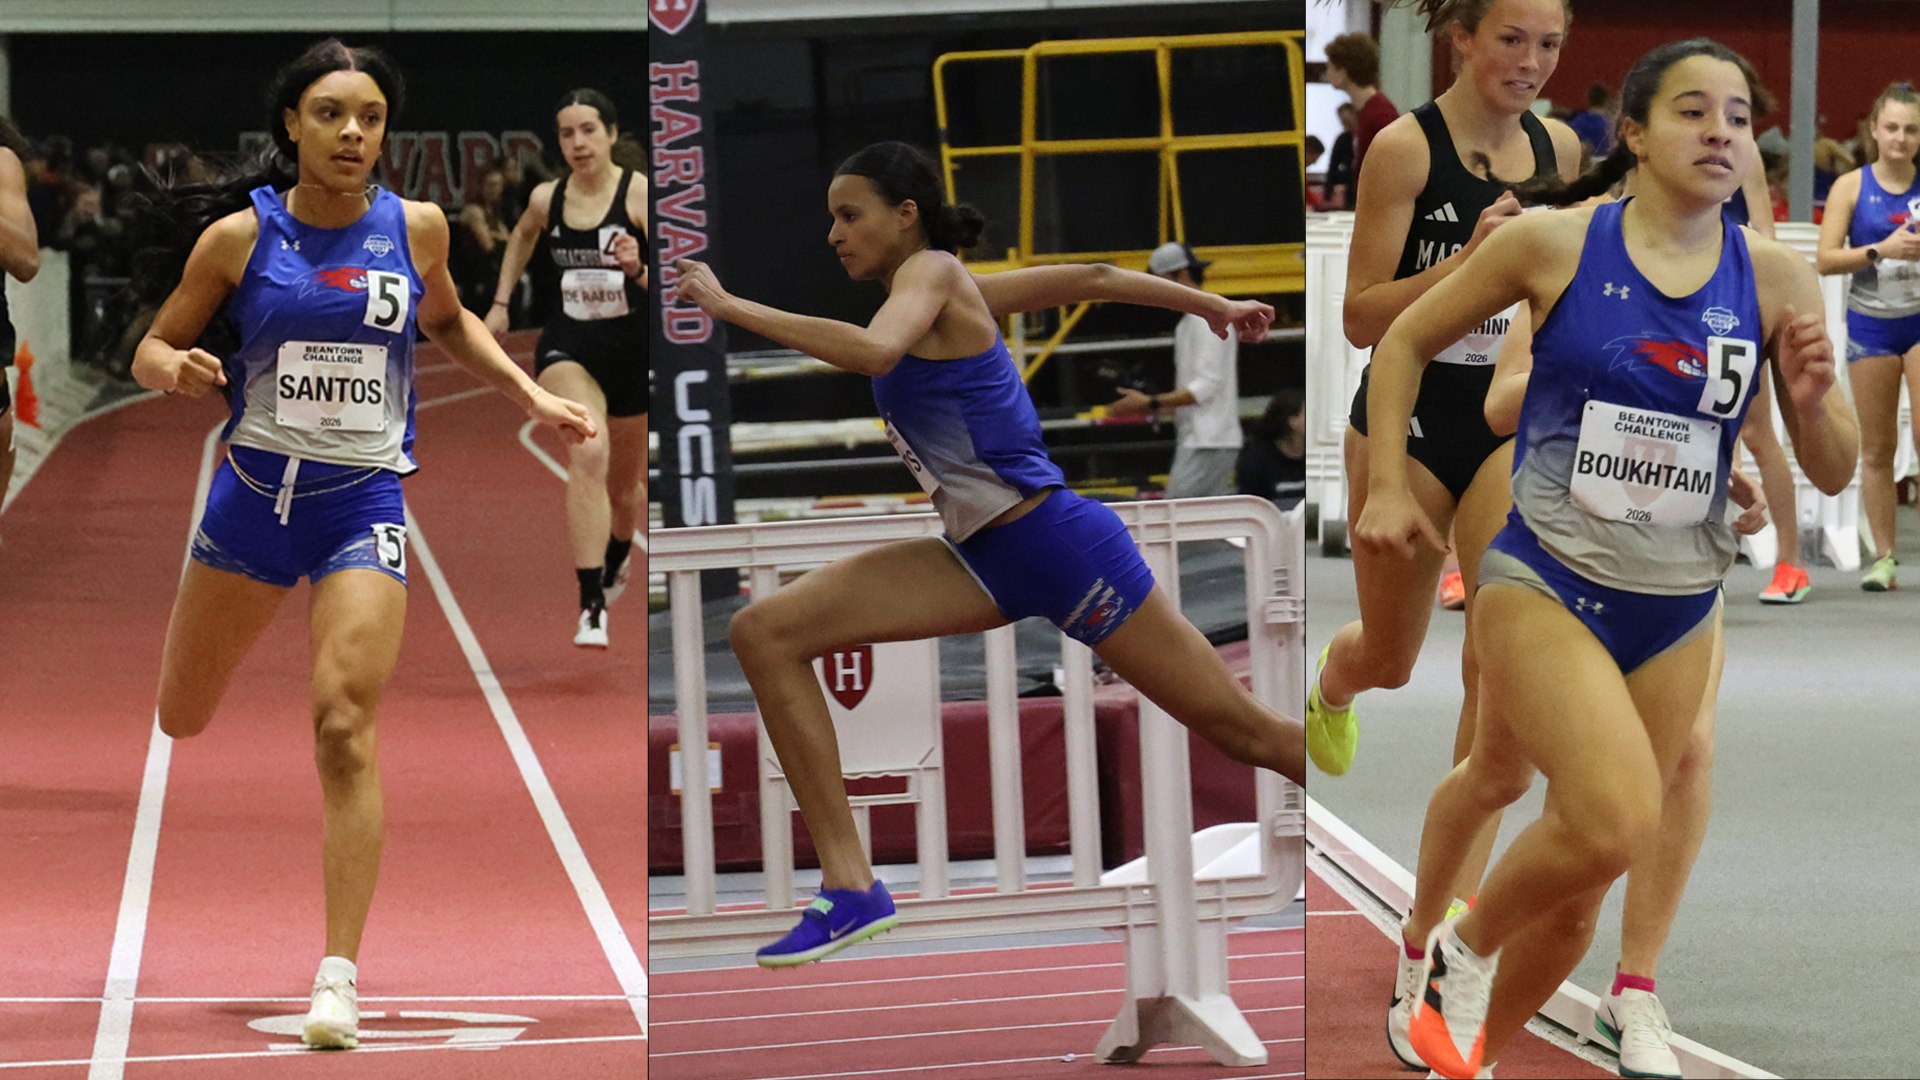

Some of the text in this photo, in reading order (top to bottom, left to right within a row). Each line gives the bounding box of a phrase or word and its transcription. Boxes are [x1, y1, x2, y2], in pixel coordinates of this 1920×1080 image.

[373, 275, 400, 327] 5
[303, 353, 364, 365] CHALLENGE
[305, 346, 363, 355] BEANTOWN
[1465, 353, 1488, 362] 2026
[279, 374, 382, 405] SANTOS
[1711, 344, 1747, 415] 5
[320, 417, 342, 427] 2026
[1614, 422, 1691, 443] CHALLENGE
[1618, 411, 1690, 432] BEANTOWN
[674, 369, 717, 526] UCS
[1577, 450, 1712, 495] BOUKHTAM
[1625, 508, 1652, 521] 2026
[384, 526, 402, 569] 5
[833, 651, 864, 691] H
